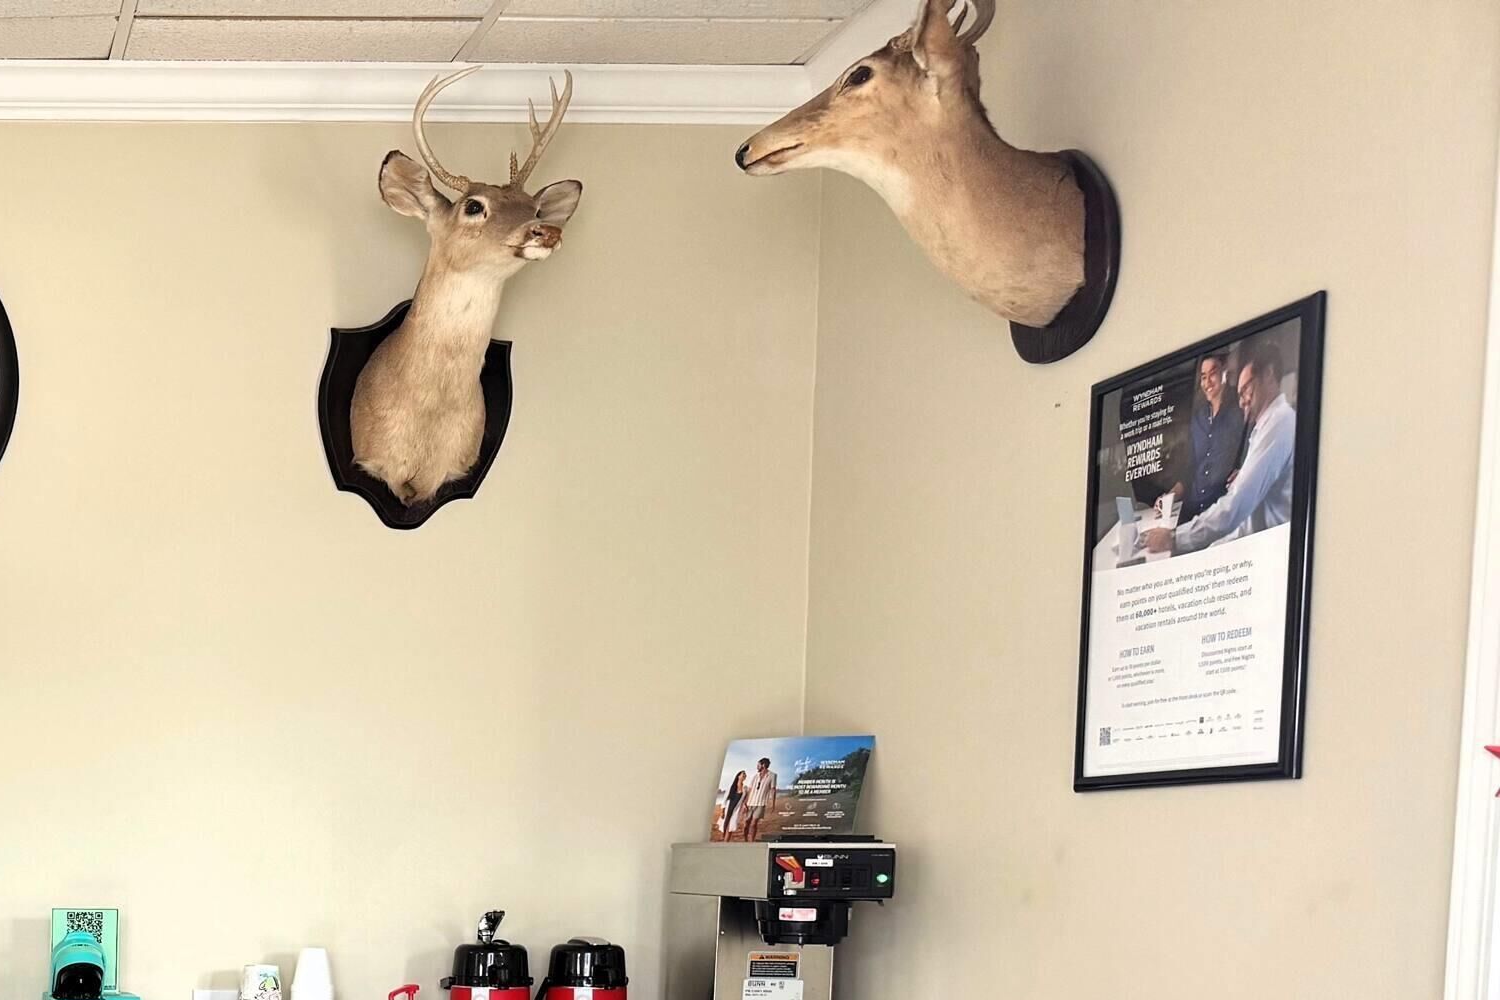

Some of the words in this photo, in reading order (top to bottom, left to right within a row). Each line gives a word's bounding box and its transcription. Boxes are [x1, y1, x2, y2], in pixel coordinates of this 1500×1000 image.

[1133, 384, 1163, 402] WYNDHAM
[1133, 395, 1162, 412] REWARDS
[1167, 405, 1175, 413] for
[1127, 433, 1164, 456] WYNDHAM
[1127, 447, 1161, 470] REWARDS
[1125, 460, 1164, 482] EVERYONE.
[1142, 583, 1153, 591] who
[1154, 580, 1163, 590] you
[1232, 563, 1238, 571] or
[1135, 608, 1157, 619] 60,000+
[1203, 595, 1216, 605] club
[1240, 586, 1252, 597] and
[1198, 611, 1208, 620] the
[1201, 633, 1217, 645] HOW
[1218, 631, 1225, 642] TO
[1227, 627, 1252, 641] REDEEM
[1119, 648, 1132, 659] HOW
[1133, 647, 1139, 656] TO
[1140, 644, 1155, 655] EARN
